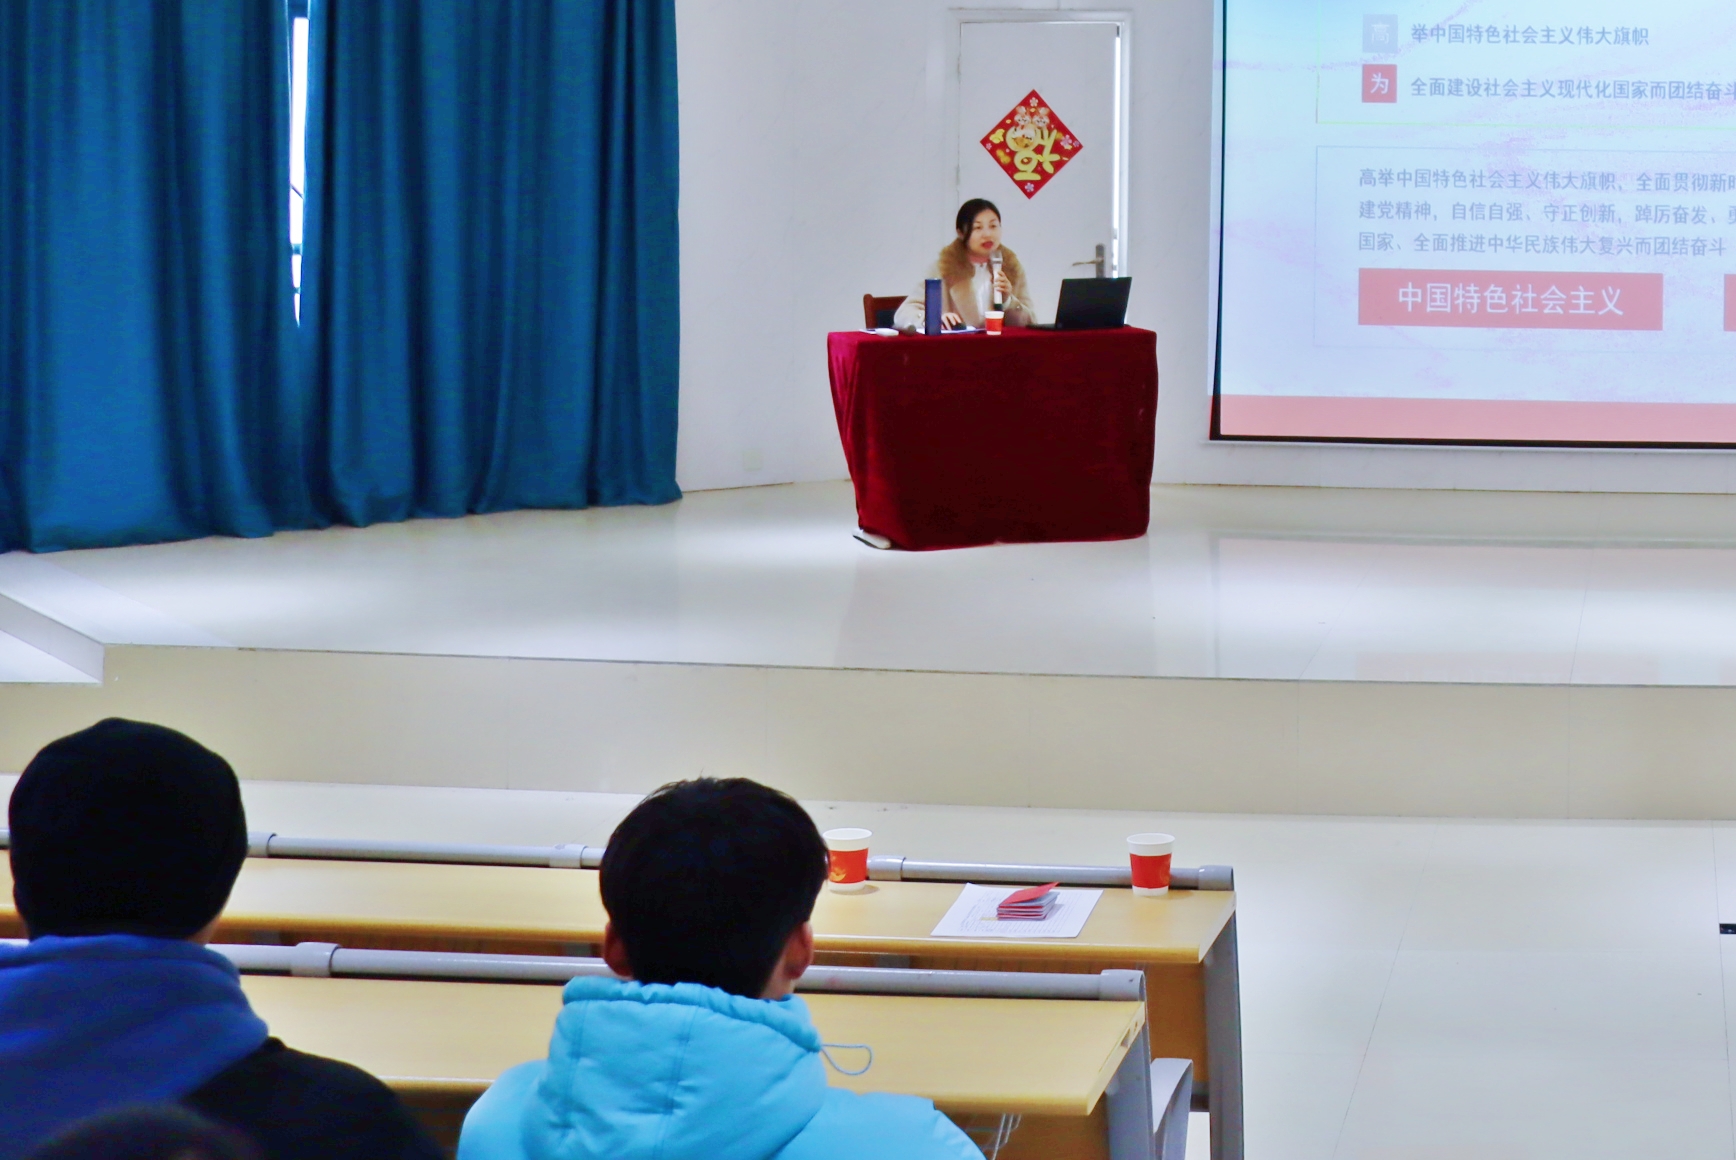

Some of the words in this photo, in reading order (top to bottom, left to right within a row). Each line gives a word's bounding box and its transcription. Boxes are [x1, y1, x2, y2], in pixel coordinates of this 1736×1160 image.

[1371, 24, 1390, 44] 高
[1410, 23, 1650, 47] 举中国特色社会主义伟大旗帜
[1370, 74, 1389, 95] 为
[1398, 281, 1624, 316] 中国特色社会主义
